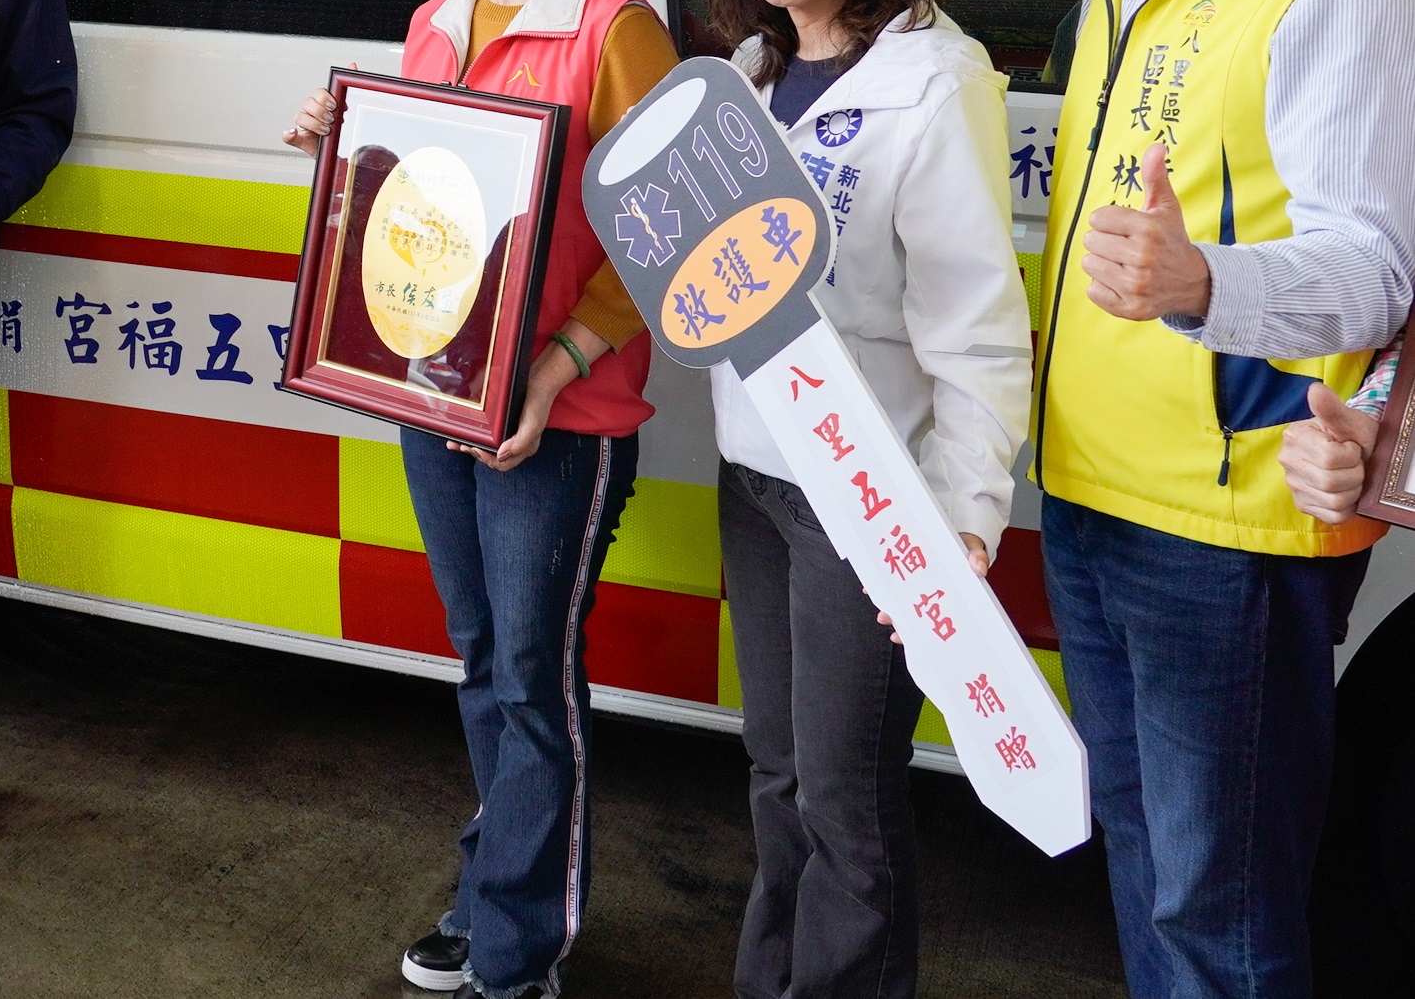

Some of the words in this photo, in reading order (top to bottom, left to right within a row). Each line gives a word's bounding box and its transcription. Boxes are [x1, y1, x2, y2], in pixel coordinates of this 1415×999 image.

[1131, 45, 1169, 131] 區長
[1153, 29, 1200, 173] 八里區公
[667, 101, 768, 222] 119
[1111, 155, 1143, 208] 林
[375, 281, 396, 298] 市長
[673, 206, 802, 341] 救護車
[789, 365, 957, 642] 八里五福宮
[965, 673, 1037, 774] 捐贈
